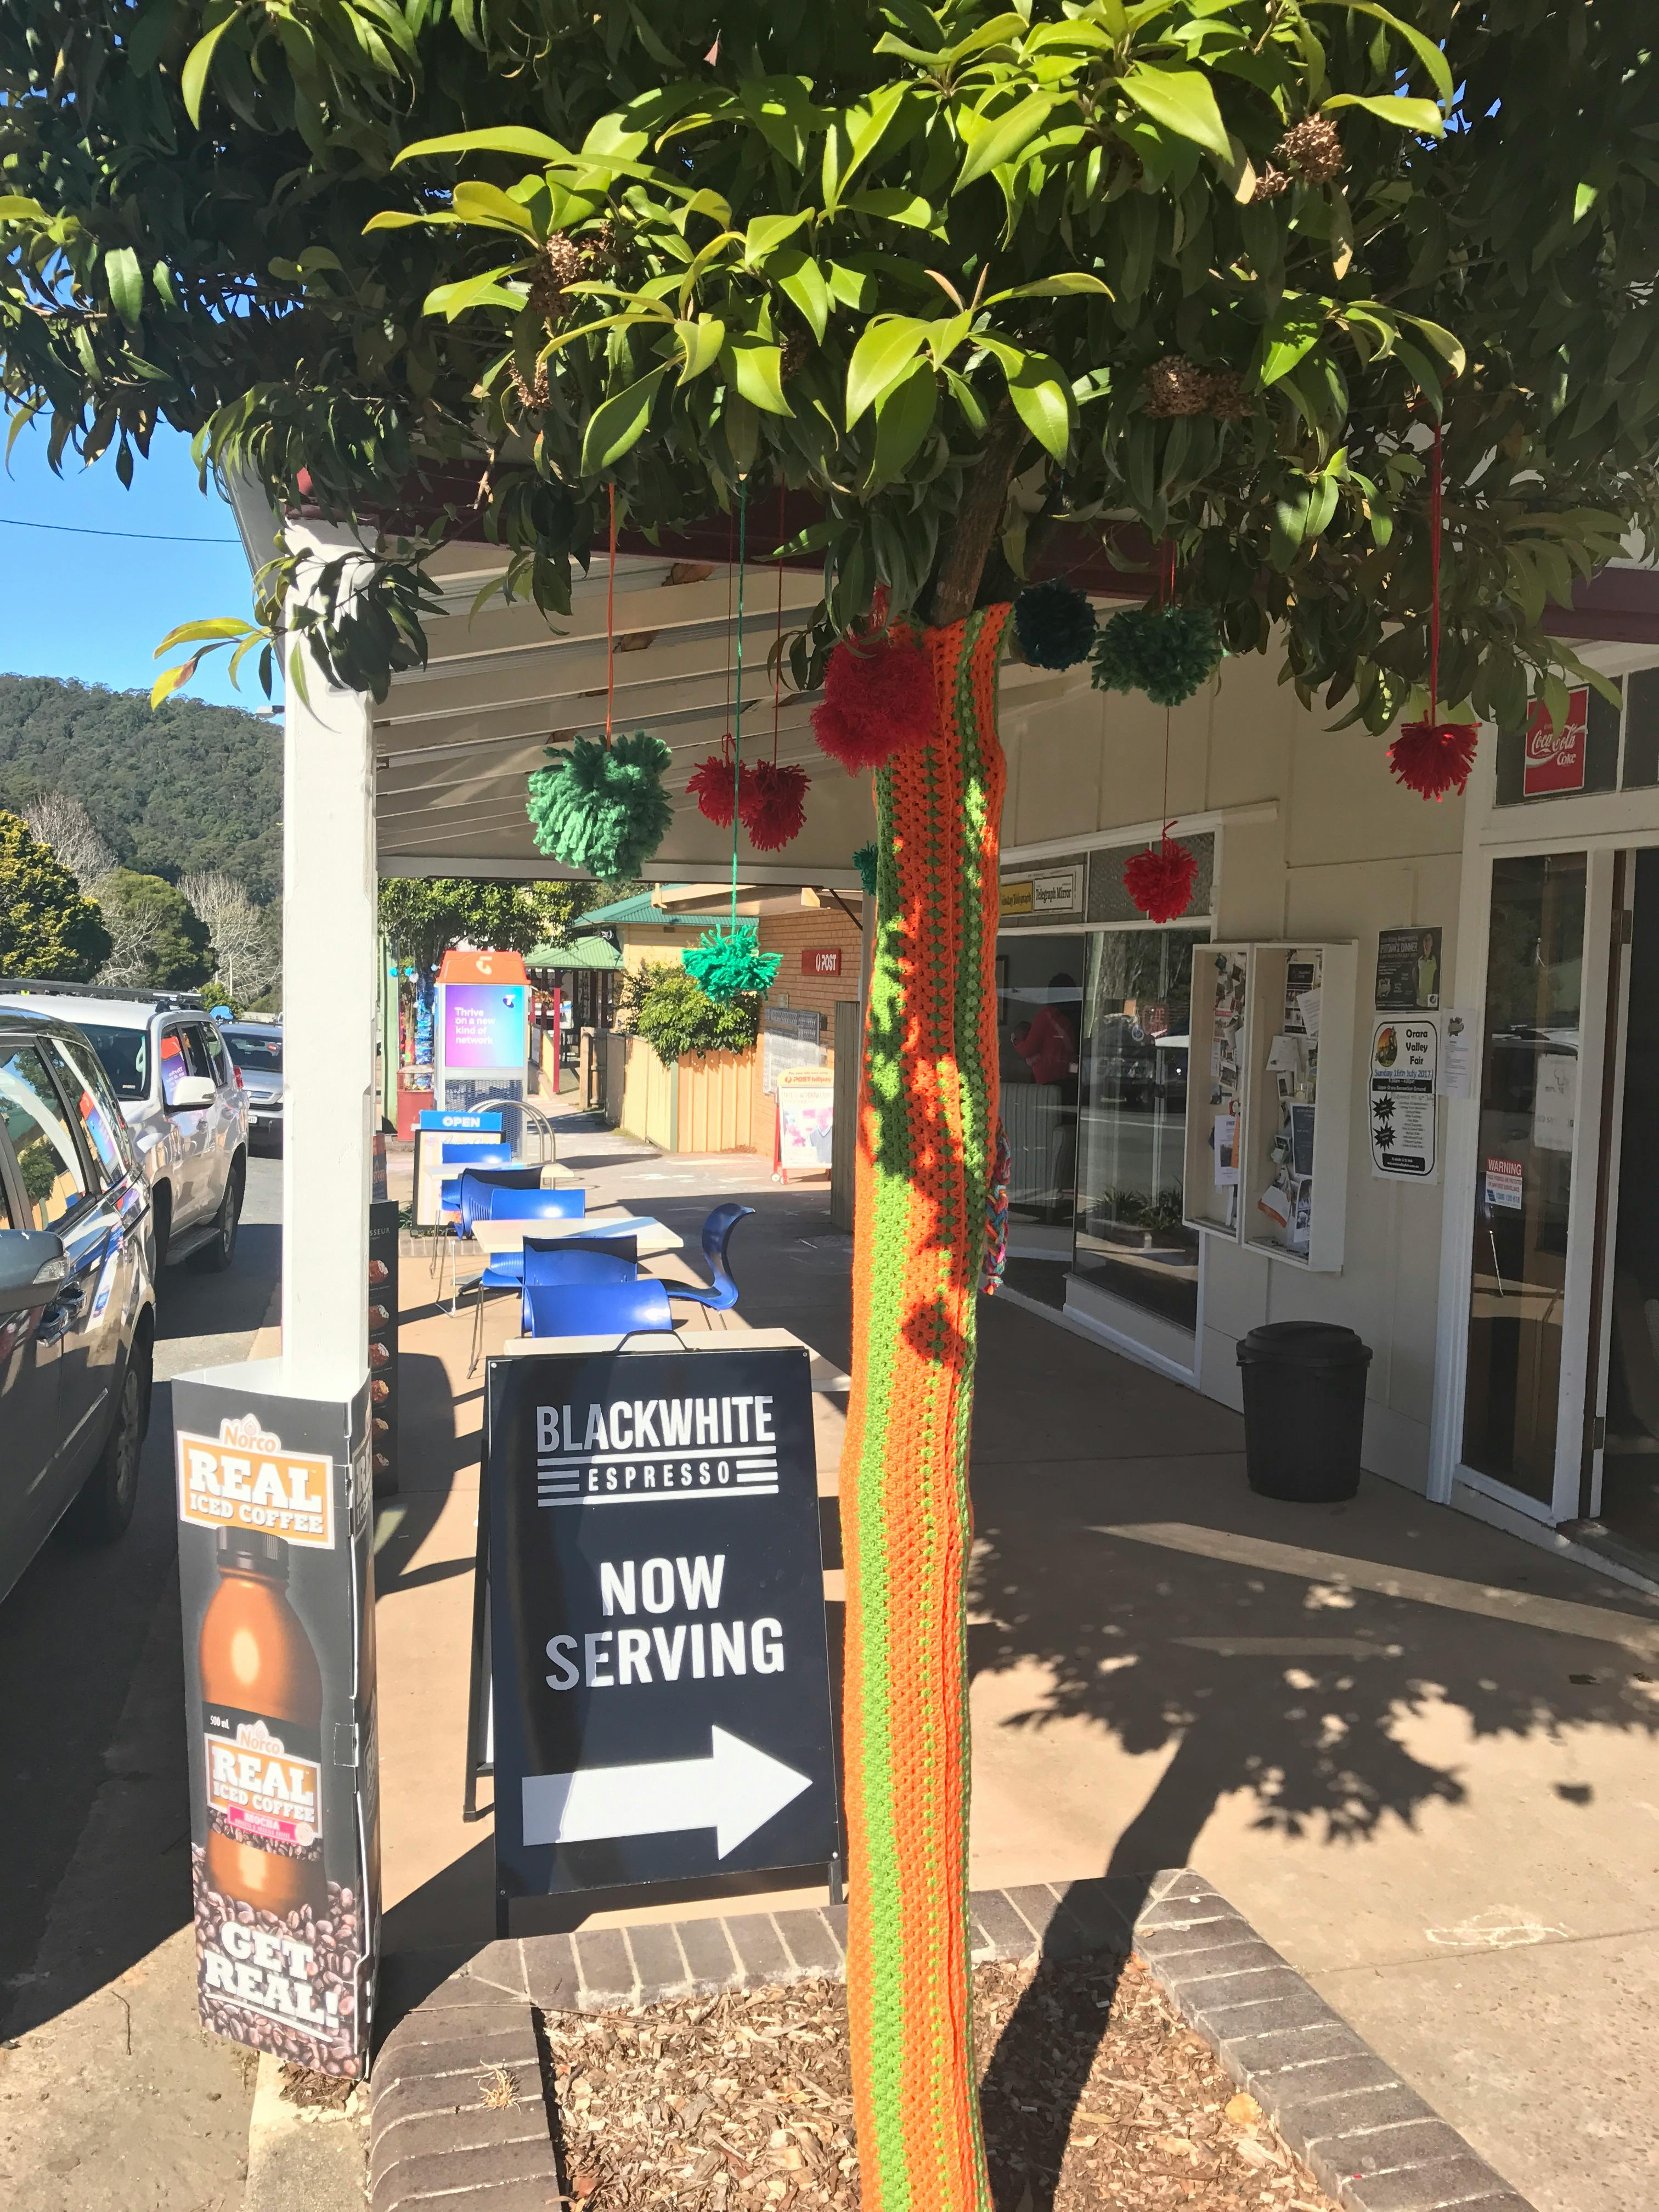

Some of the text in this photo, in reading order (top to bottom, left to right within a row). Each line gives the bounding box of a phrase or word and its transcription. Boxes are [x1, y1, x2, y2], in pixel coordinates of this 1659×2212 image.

[1532, 724, 1577, 755] CocaCola
[1557, 752, 1576, 765] Coke
[1036, 887, 1071, 904] Telegraph Mirror
[822, 954, 836, 971] POST
[454, 1007, 484, 1017] Thrive
[455, 1026, 488, 1035] kind of
[1406, 1029, 1428, 1038] Orara
[455, 1036, 493, 1045] network
[1406, 1042, 1428, 1053] Valley
[1409, 1056, 1424, 1065] Fair
[1375, 1069, 1392, 1077] Sunday
[1407, 1070, 1417, 1079] July
[1418, 1070, 1431, 1078] 2017
[442, 1116, 481, 1127] OPEN
[1488, 1159, 1522, 1175] WARNING
[537, 1395, 776, 1453] BLACKWHITE
[223, 1424, 276, 1453] Norco
[188, 1448, 323, 1513] REAL
[588, 1460, 730, 1492] ESPRESSO
[190, 1492, 324, 1534] ICED COFFEE
[600, 1554, 726, 1616] NOW
[545, 1617, 785, 1691] SERVING
[210, 1715, 221, 1726] 500
[240, 1729, 280, 1755] Norco
[212, 1745, 314, 1807] REAL
[213, 1781, 315, 1823] ICED COFFEE
[244, 1812, 280, 1831] MOCHA
[221, 1920, 314, 1980] GET
[204, 1949, 340, 2029] REAL!
